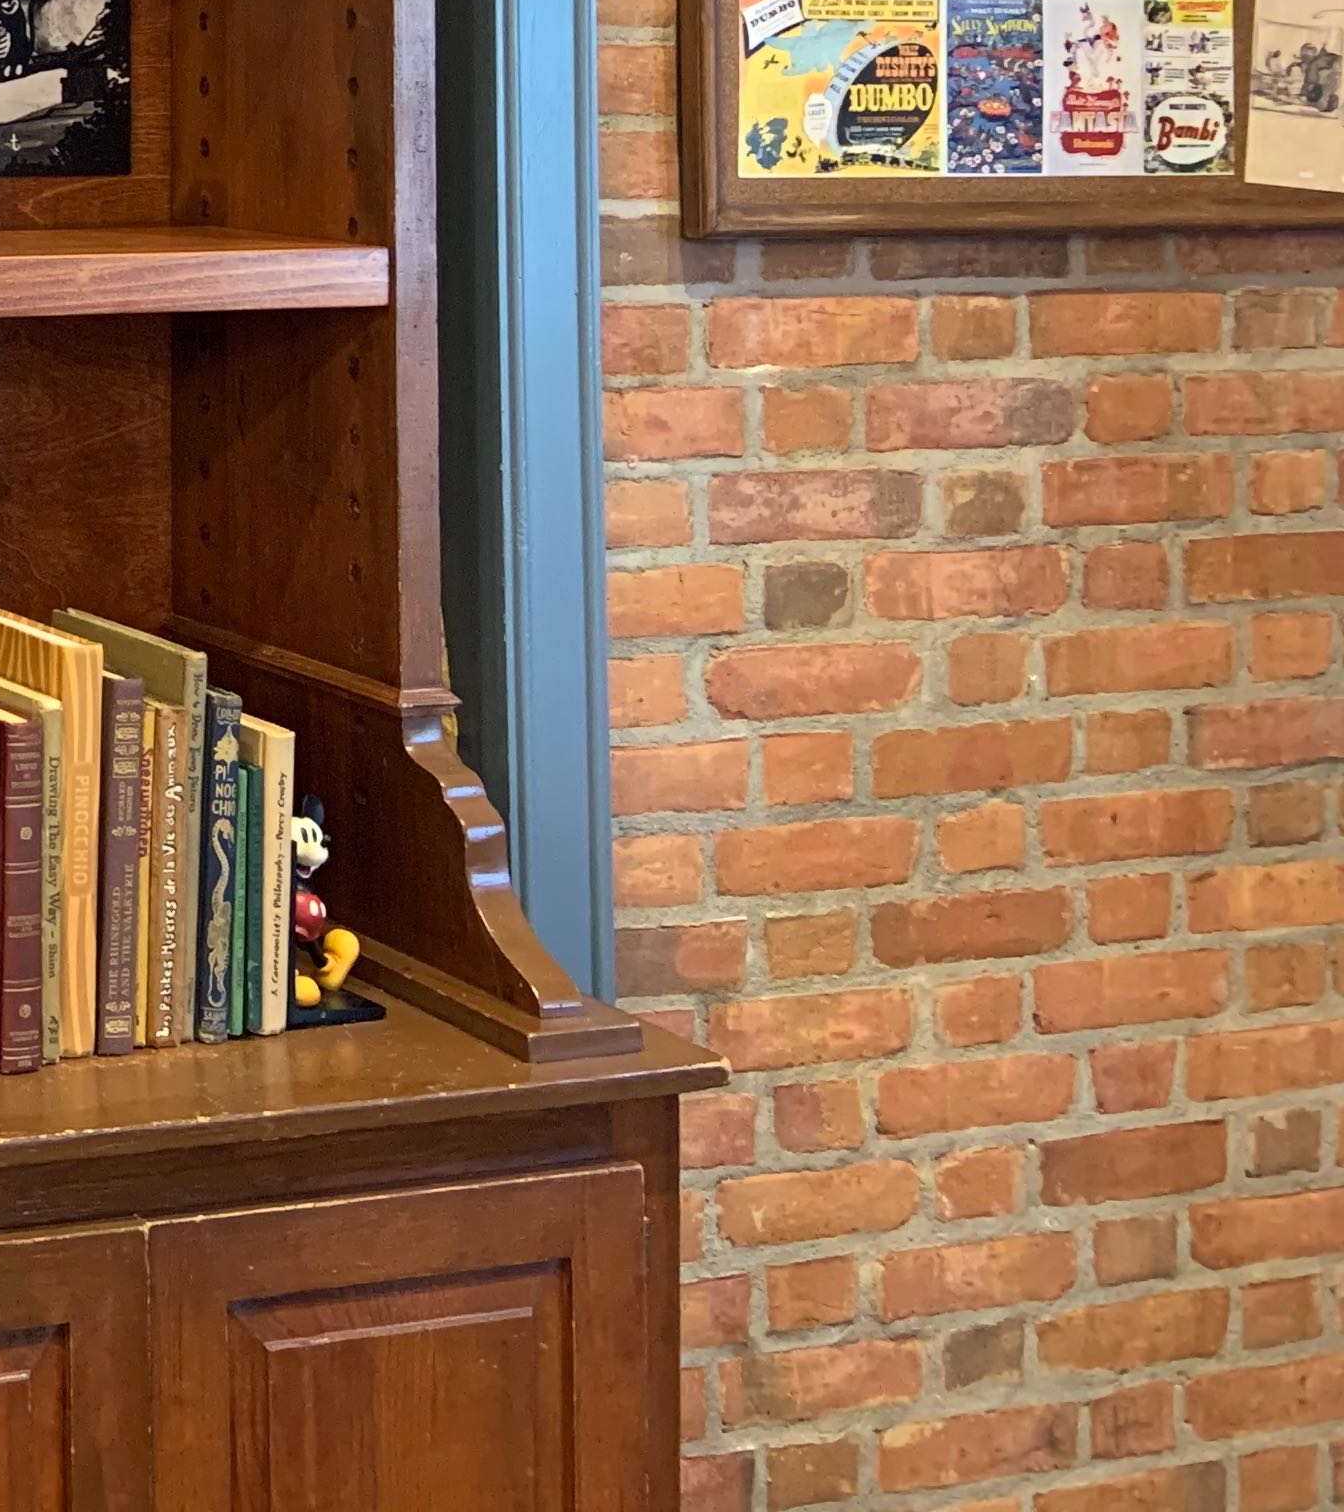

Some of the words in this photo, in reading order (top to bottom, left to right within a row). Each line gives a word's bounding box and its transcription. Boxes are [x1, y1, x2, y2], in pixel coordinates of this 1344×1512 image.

[749, 0, 797, 29] DUMBO
[951, 15, 983, 37] SILLY
[985, 16, 1038, 38] SYMPHONY
[848, 82, 935, 113] DUMBO
[1049, 110, 1139, 134] FANTASIA
[1154, 115, 1221, 154] Bambi
[164, 721, 184, 803] Animaux
[46, 755, 61, 819] Drawing
[163, 803, 176, 826] des
[47, 823, 61, 851] The
[71, 774, 91, 886] PINOCCHIO
[162, 831, 176, 857] Vie
[45, 853, 61, 888] Easy
[163, 860, 176, 874] la
[272, 852, 286, 908] Philosophy
[122, 863, 135, 932] VALKYRIE
[163, 878, 178, 896] de
[45, 890, 61, 925] Way
[109, 886, 122, 966] RHINEGOLD
[121, 934, 132, 963] THE
[107, 968, 120, 996] THE
[120, 967, 132, 997] AND
[159, 957, 175, 1012] Petites
